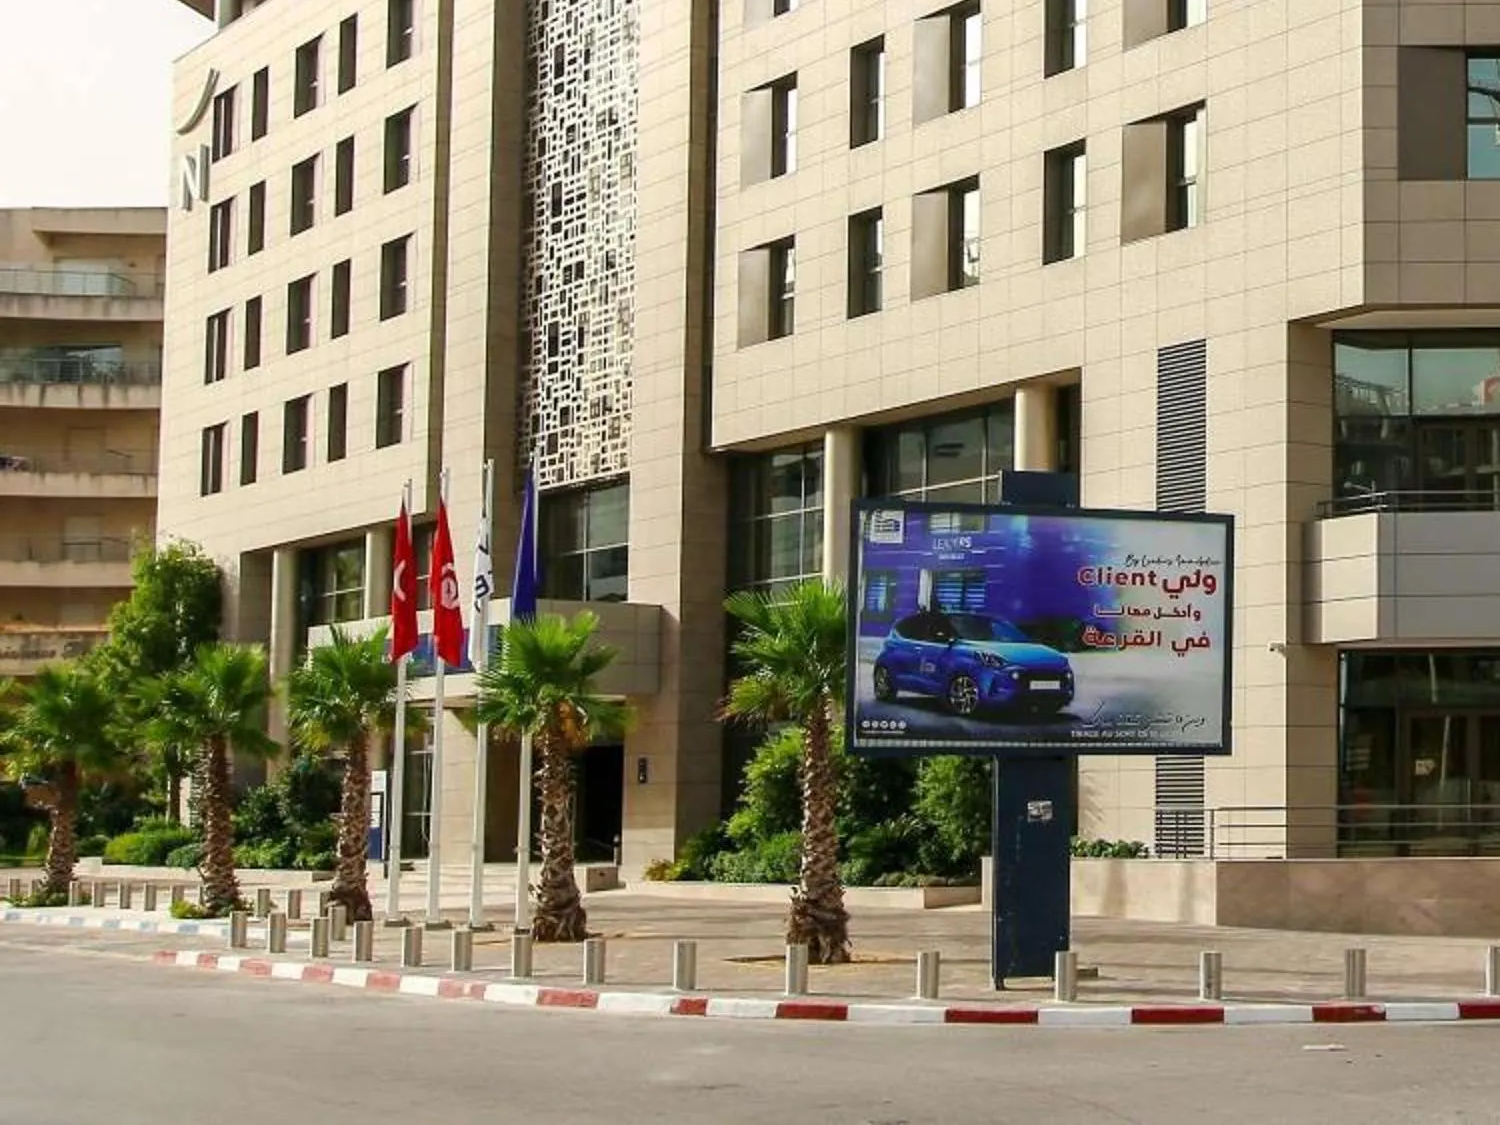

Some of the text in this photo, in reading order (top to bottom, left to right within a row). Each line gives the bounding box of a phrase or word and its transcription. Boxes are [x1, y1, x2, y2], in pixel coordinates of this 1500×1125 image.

[1077, 565, 1158, 586] Client
[1081, 625, 1212, 658] في القرعة
